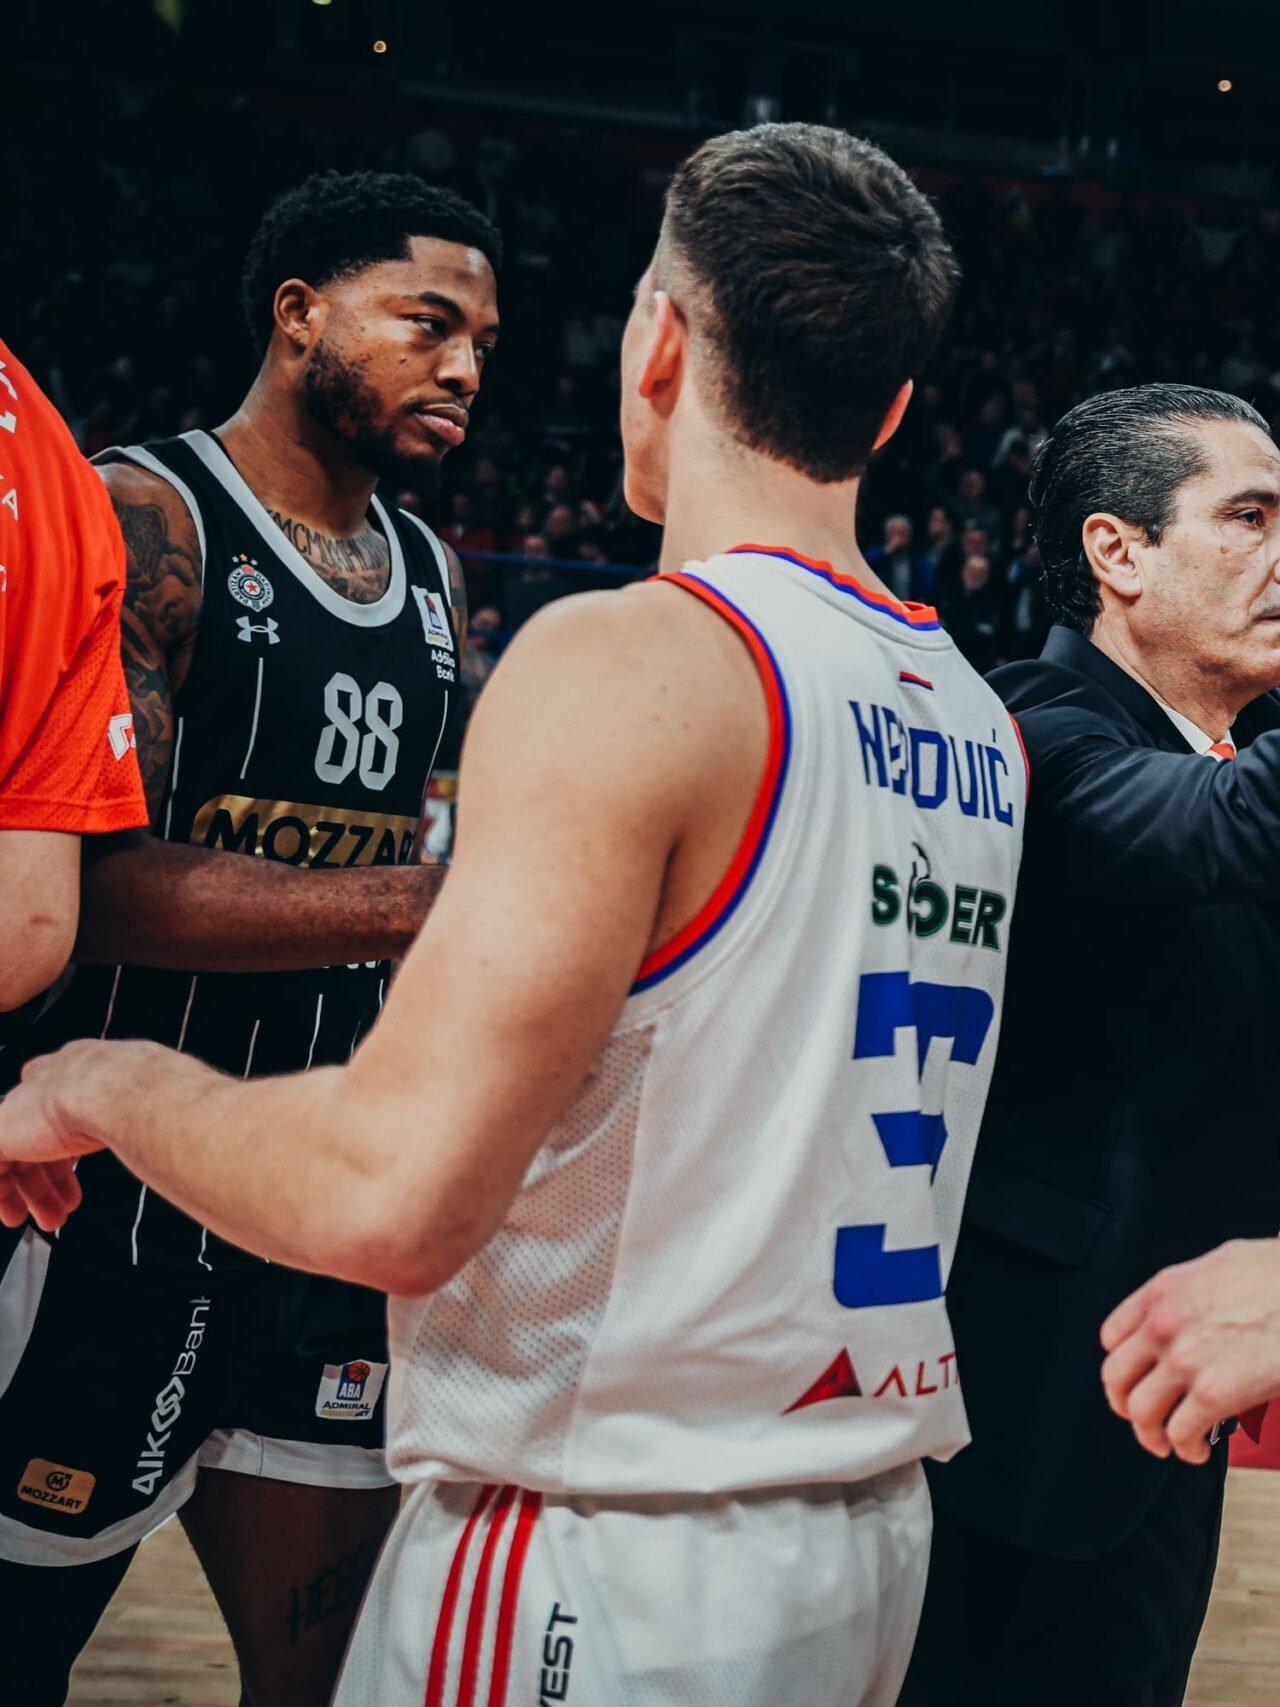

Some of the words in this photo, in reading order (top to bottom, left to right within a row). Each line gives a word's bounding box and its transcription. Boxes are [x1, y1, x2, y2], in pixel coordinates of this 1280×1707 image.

[436, 665, 455, 682] Bank
[314, 671, 404, 791] 88
[338, 1382, 361, 1399] ABA
[322, 1401, 372, 1410] ADMIRAL
[21, 1485, 83, 1509] MOZZART
